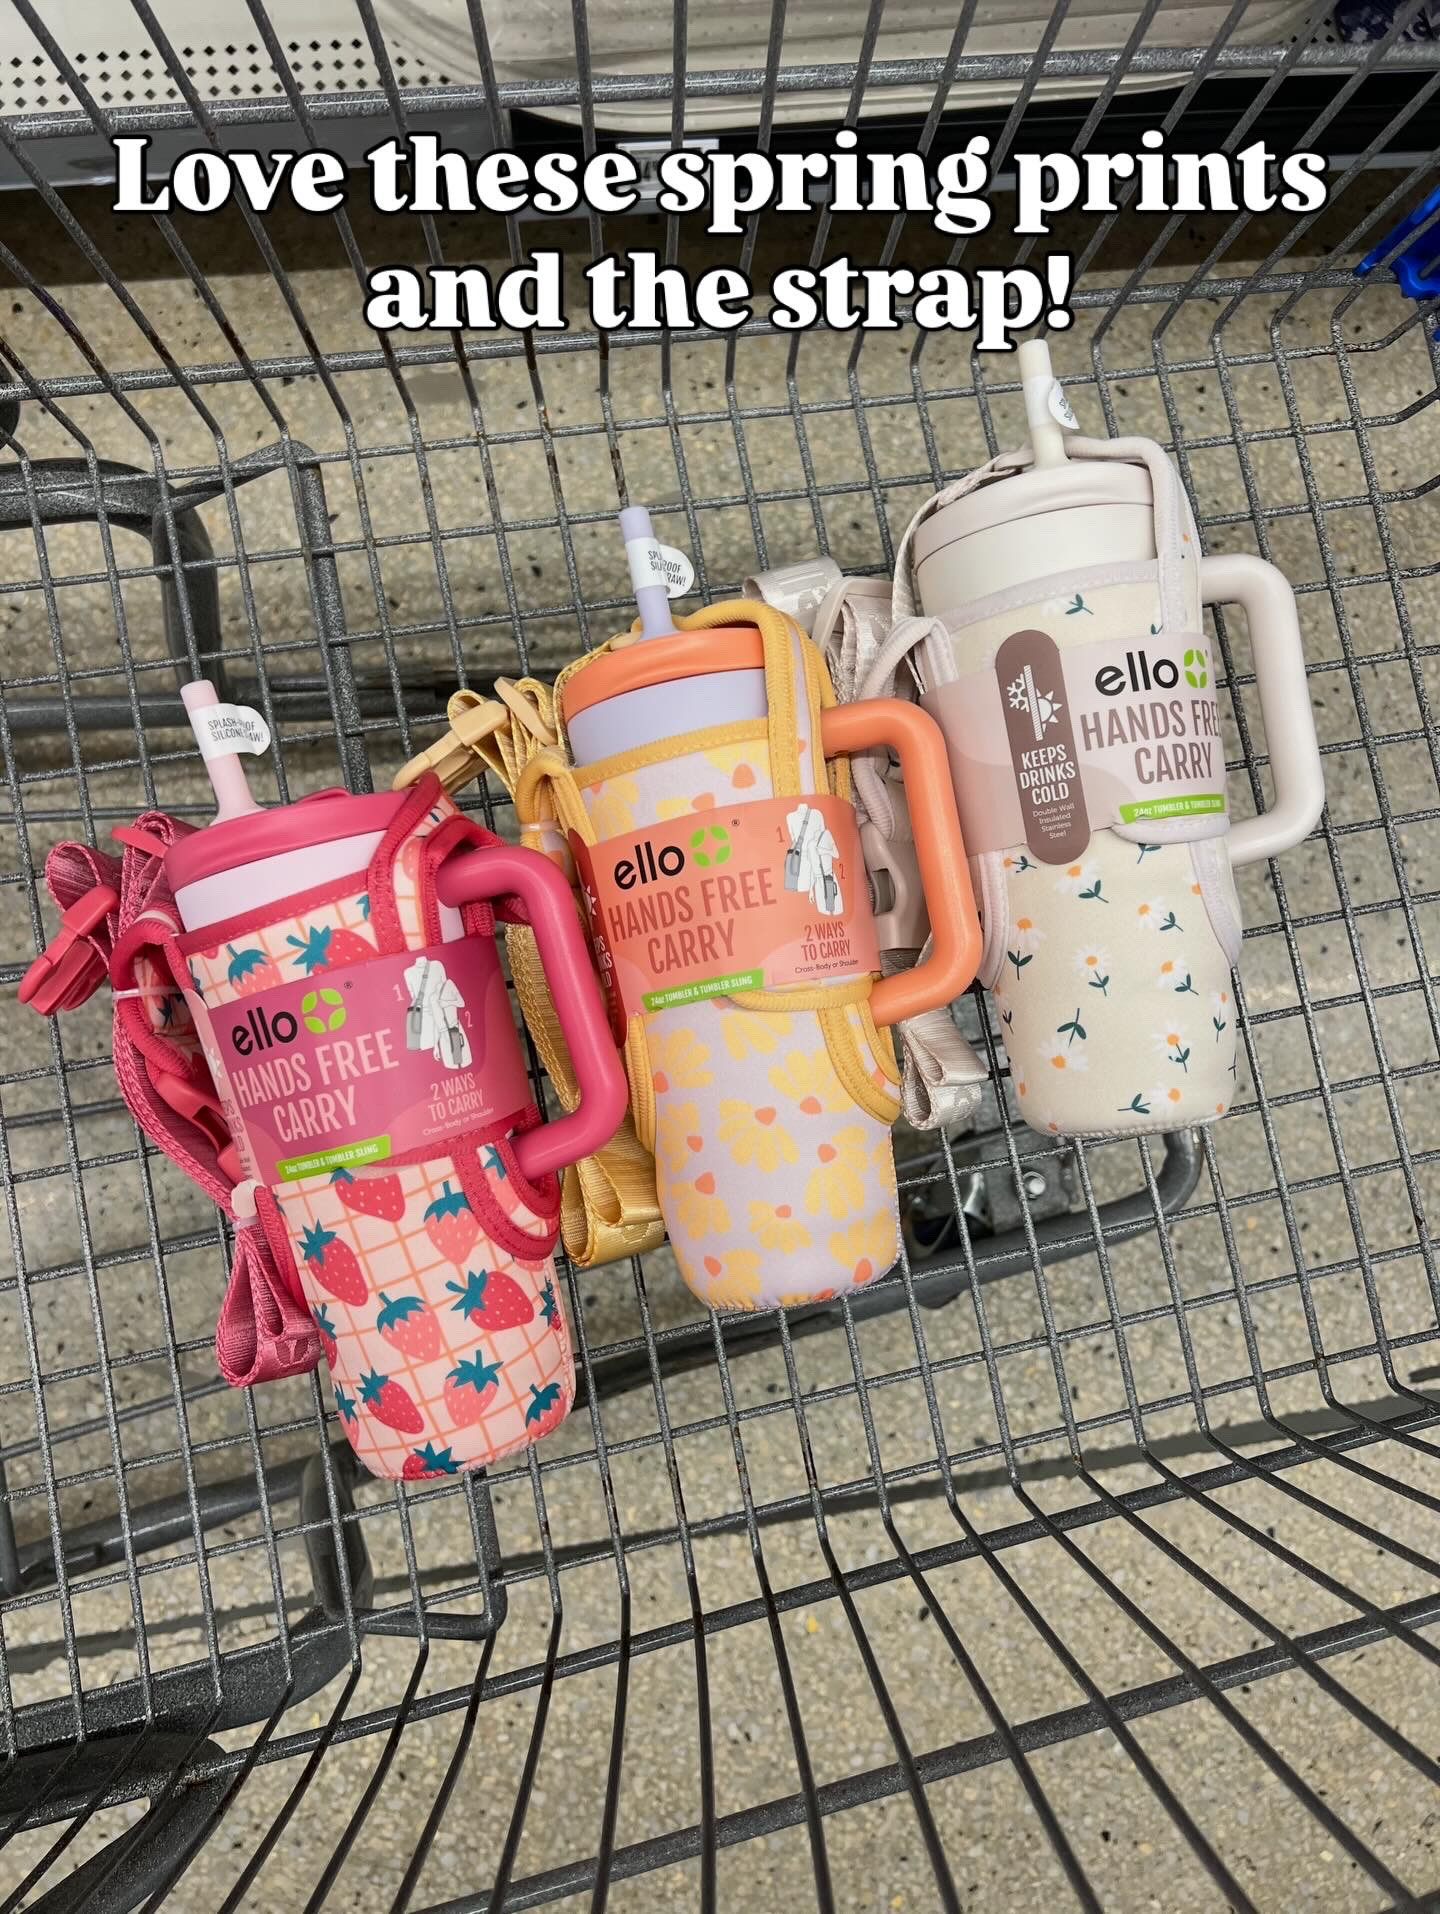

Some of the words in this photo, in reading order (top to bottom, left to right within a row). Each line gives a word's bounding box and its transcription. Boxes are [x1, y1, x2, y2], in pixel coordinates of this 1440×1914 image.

[1094, 650, 1180, 697] ello
[1079, 700, 1187, 752] HANDS
[1021, 743, 1067, 770] KEEPS
[1133, 741, 1213, 785] CARRY
[1019, 761, 1076, 790] DRINKS
[1031, 782, 1070, 805] COLD
[1032, 807, 1058, 818] Double
[1058, 802, 1075, 812] Wall
[1038, 812, 1072, 825] Insulated
[776, 826, 785, 844] 1
[1040, 820, 1072, 833] Stainless
[1049, 829, 1067, 840] Steel
[613, 840, 685, 891] ello
[838, 863, 846, 880] 2
[607, 885, 694, 943] HANDS
[700, 867, 778, 917] FREE
[803, 924, 813, 942] 2
[814, 920, 845, 942] WAYS
[647, 917, 736, 975] CARRY
[801, 943, 818, 962] TO
[819, 938, 852, 960] CARRY
[794, 962, 832, 974] Cross-Body
[832, 961, 838, 969] or
[392, 983, 405, 1002] 1
[664, 988, 693, 1003] TUMBLER
[693, 987, 699, 996] &
[699, 979, 730, 994] TUMBLER
[731, 975, 753, 988] SLING
[231, 1006, 298, 1056] ello
[464, 1010, 473, 1028] 2
[232, 1052, 312, 1109] HANDS
[314, 1028, 400, 1086] FREE
[430, 1082, 441, 1101] 2
[441, 1072, 476, 1097] WAYS
[272, 1085, 357, 1143] CARRY
[428, 1102, 446, 1122] TO
[447, 1088, 485, 1117] CARRY
[422, 1118, 462, 1137] Cross-Body
[463, 1115, 471, 1123] or
[355, 1143, 379, 1158] SLING
